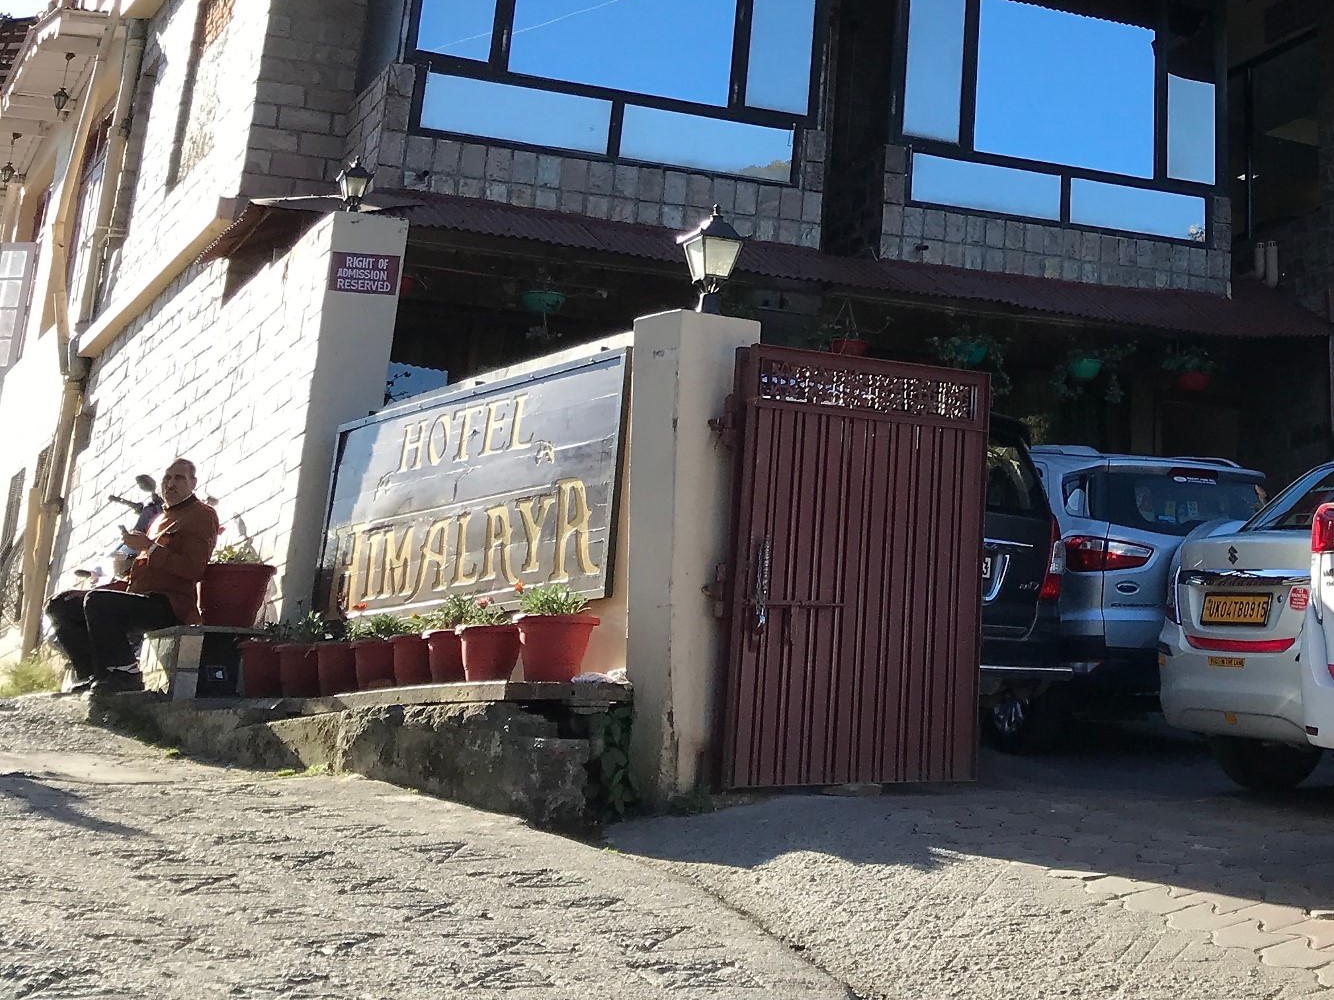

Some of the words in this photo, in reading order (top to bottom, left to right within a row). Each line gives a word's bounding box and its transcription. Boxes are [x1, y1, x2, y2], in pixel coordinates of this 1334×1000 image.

[346, 256, 375, 269] RIGHT
[378, 259, 389, 269] OF
[337, 268, 387, 280] ADMISSION
[337, 279, 391, 292] RESERVED
[396, 394, 535, 474] HOTEL
[330, 477, 600, 619] HIMALAYA
